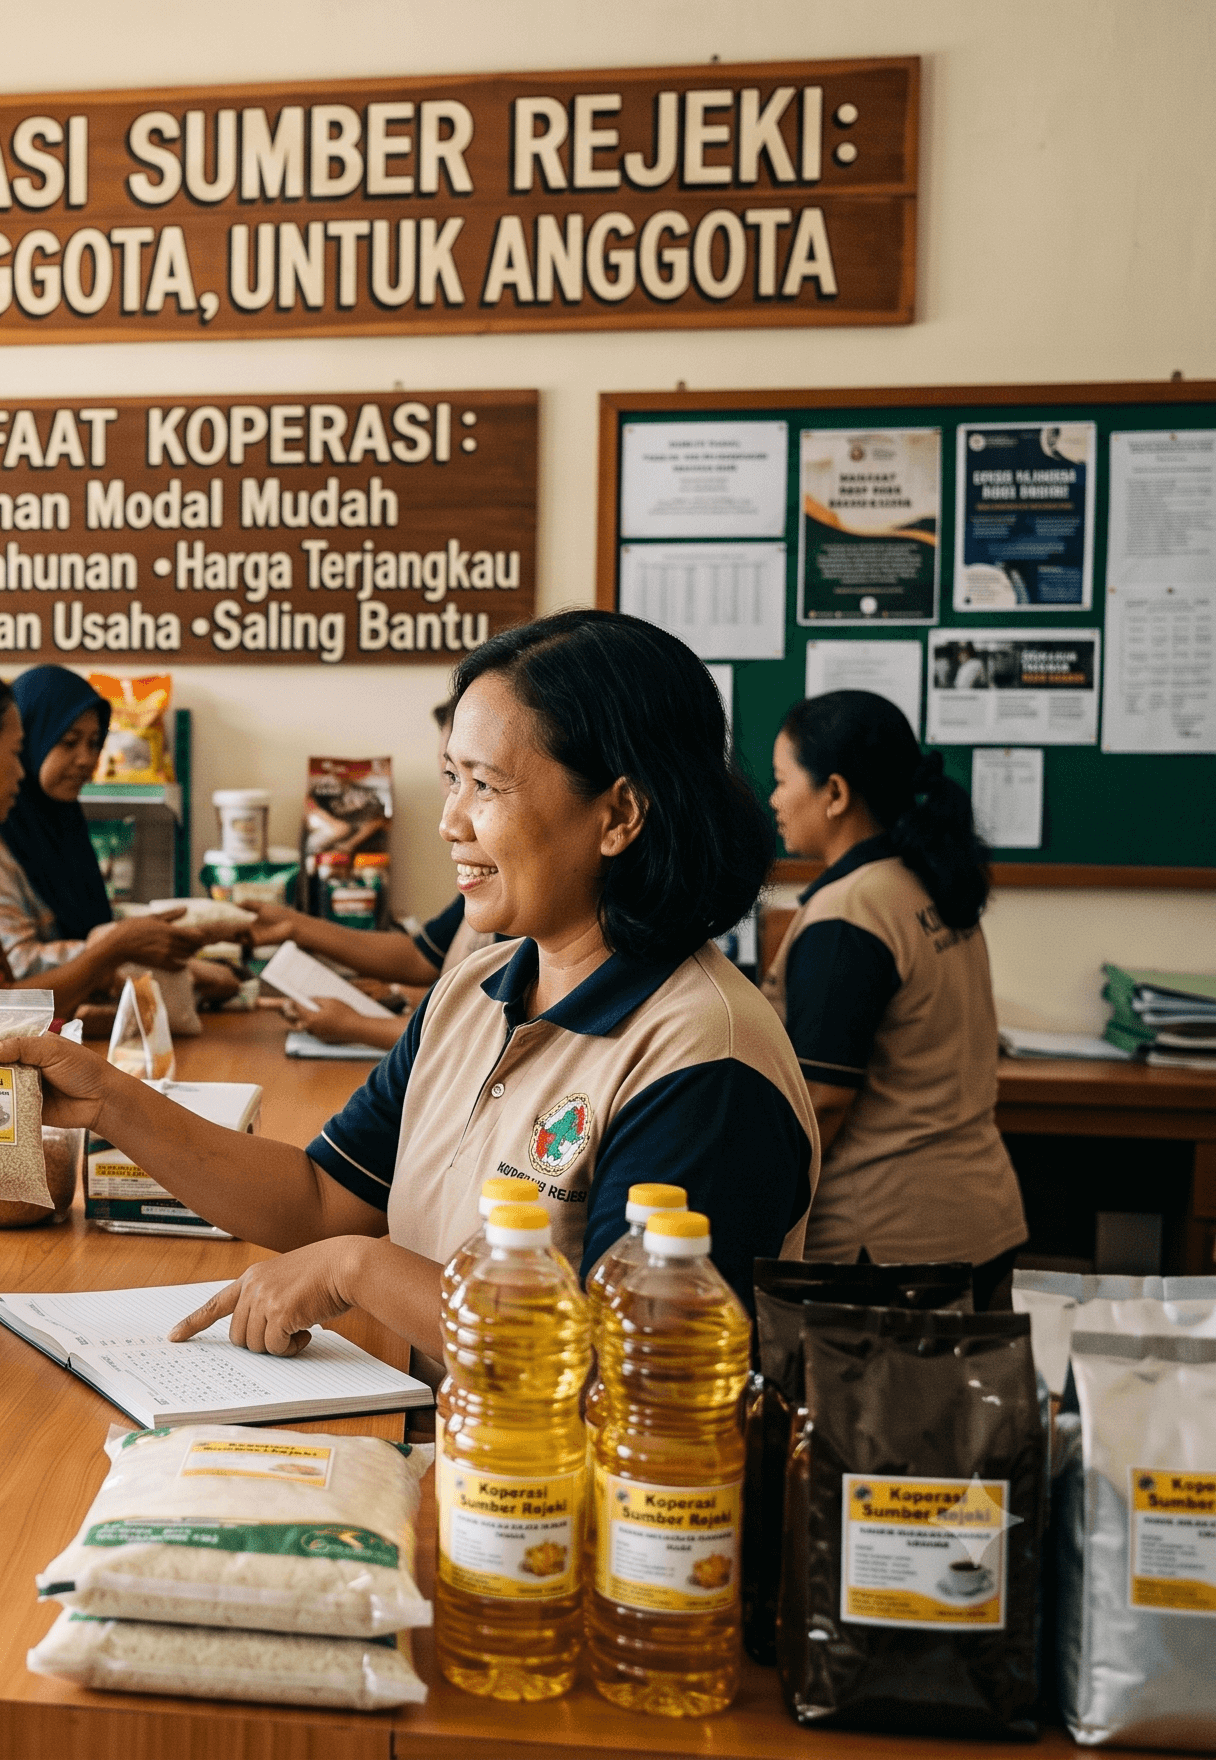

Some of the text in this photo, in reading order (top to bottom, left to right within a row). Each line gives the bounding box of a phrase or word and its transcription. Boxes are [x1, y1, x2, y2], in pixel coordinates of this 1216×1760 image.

[128, 99, 475, 205] SUMBER
[513, 86, 859, 191] REJEKI:
[230, 216, 466, 310] UNTUK
[483, 207, 839, 304] ANGGOTA
[147, 402, 478, 466] KOPERASI:
[86, 478, 224, 529] Modal
[241, 476, 399, 528] Mudah
[301, 538, 521, 602] Terjangkau
[53, 600, 182, 651] Usaha
[359, 600, 489, 650] Bantu
[460, 1494, 517, 1514] Sumber
[479, 1482, 548, 1500] Koperasi
[622, 1506, 683, 1525] Sumber
[645, 1494, 717, 1510] Koperasi
[863, 1503, 931, 1520] Sumber
